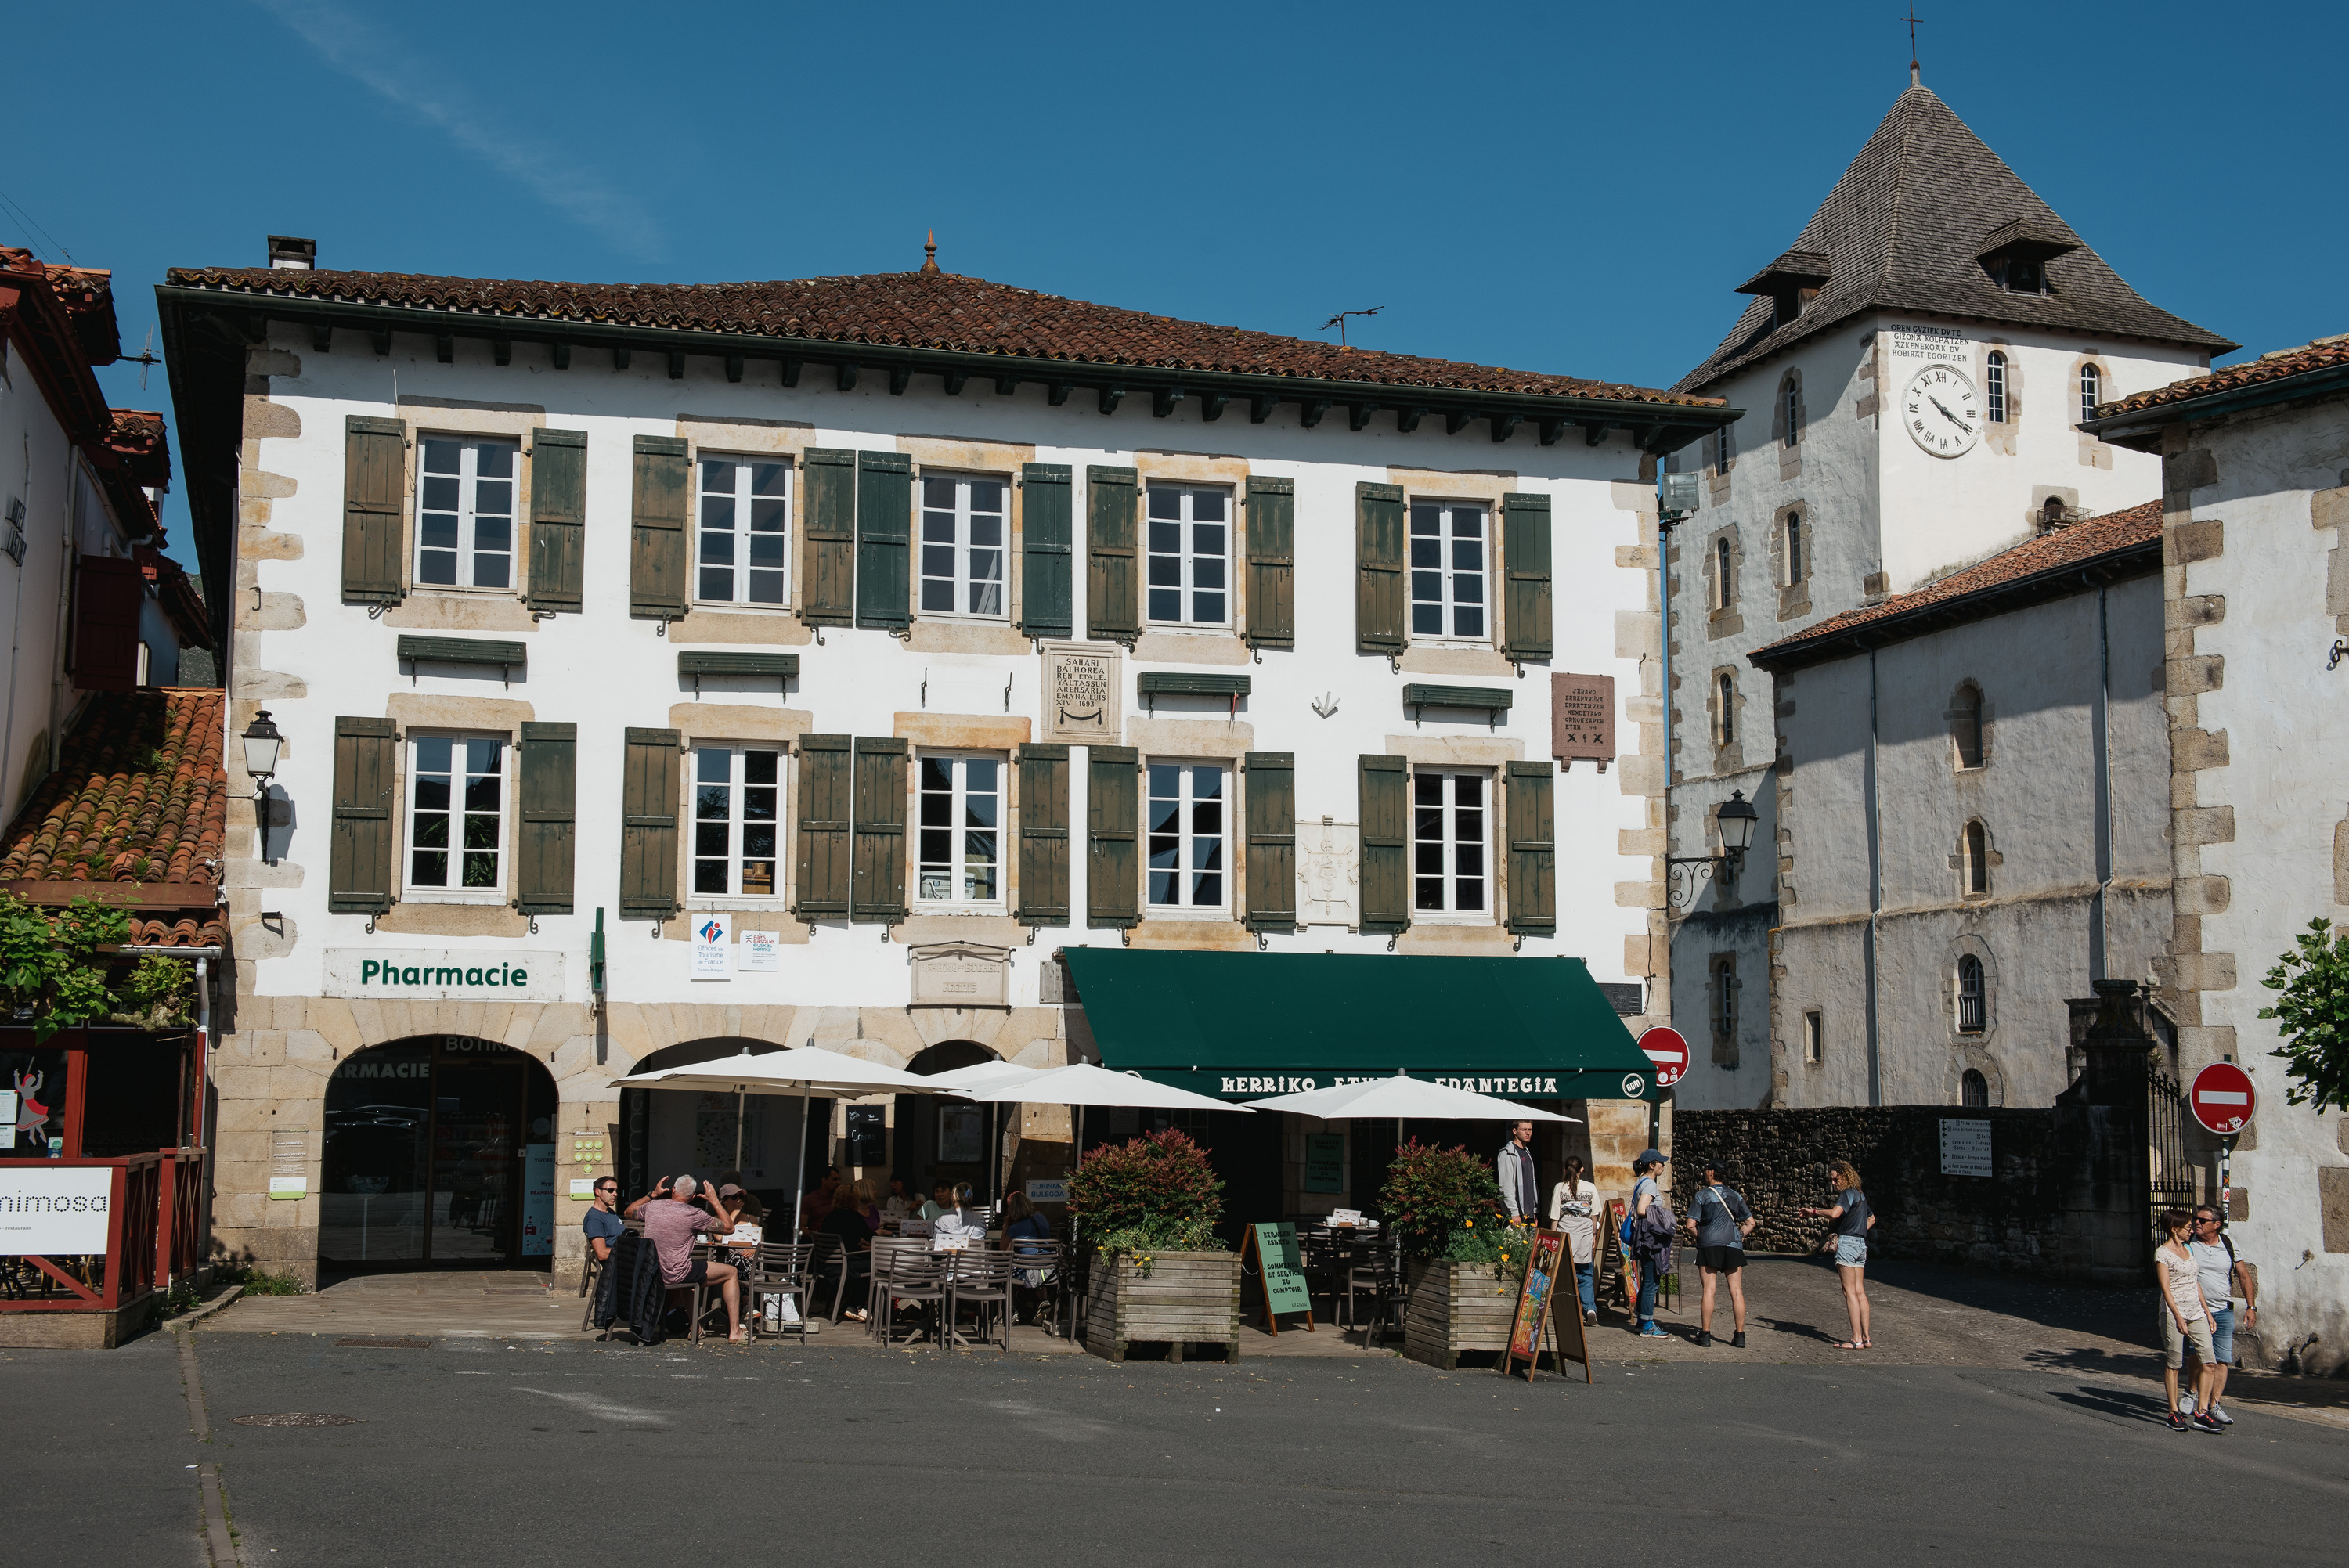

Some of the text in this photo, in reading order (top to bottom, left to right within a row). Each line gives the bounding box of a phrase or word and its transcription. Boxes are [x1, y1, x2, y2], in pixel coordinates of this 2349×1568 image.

[1894, 341, 1946, 351] AZKENEKOAK
[1925, 336, 1969, 345] KOLPATZEN
[1928, 352, 1967, 362] EGORTZEN
[362, 960, 528, 987] Pharmacie
[943, 982, 977, 993] MAIRIE
[1221, 1076, 1315, 1093] HERRIKO
[1626, 1079, 1641, 1092] BDM
